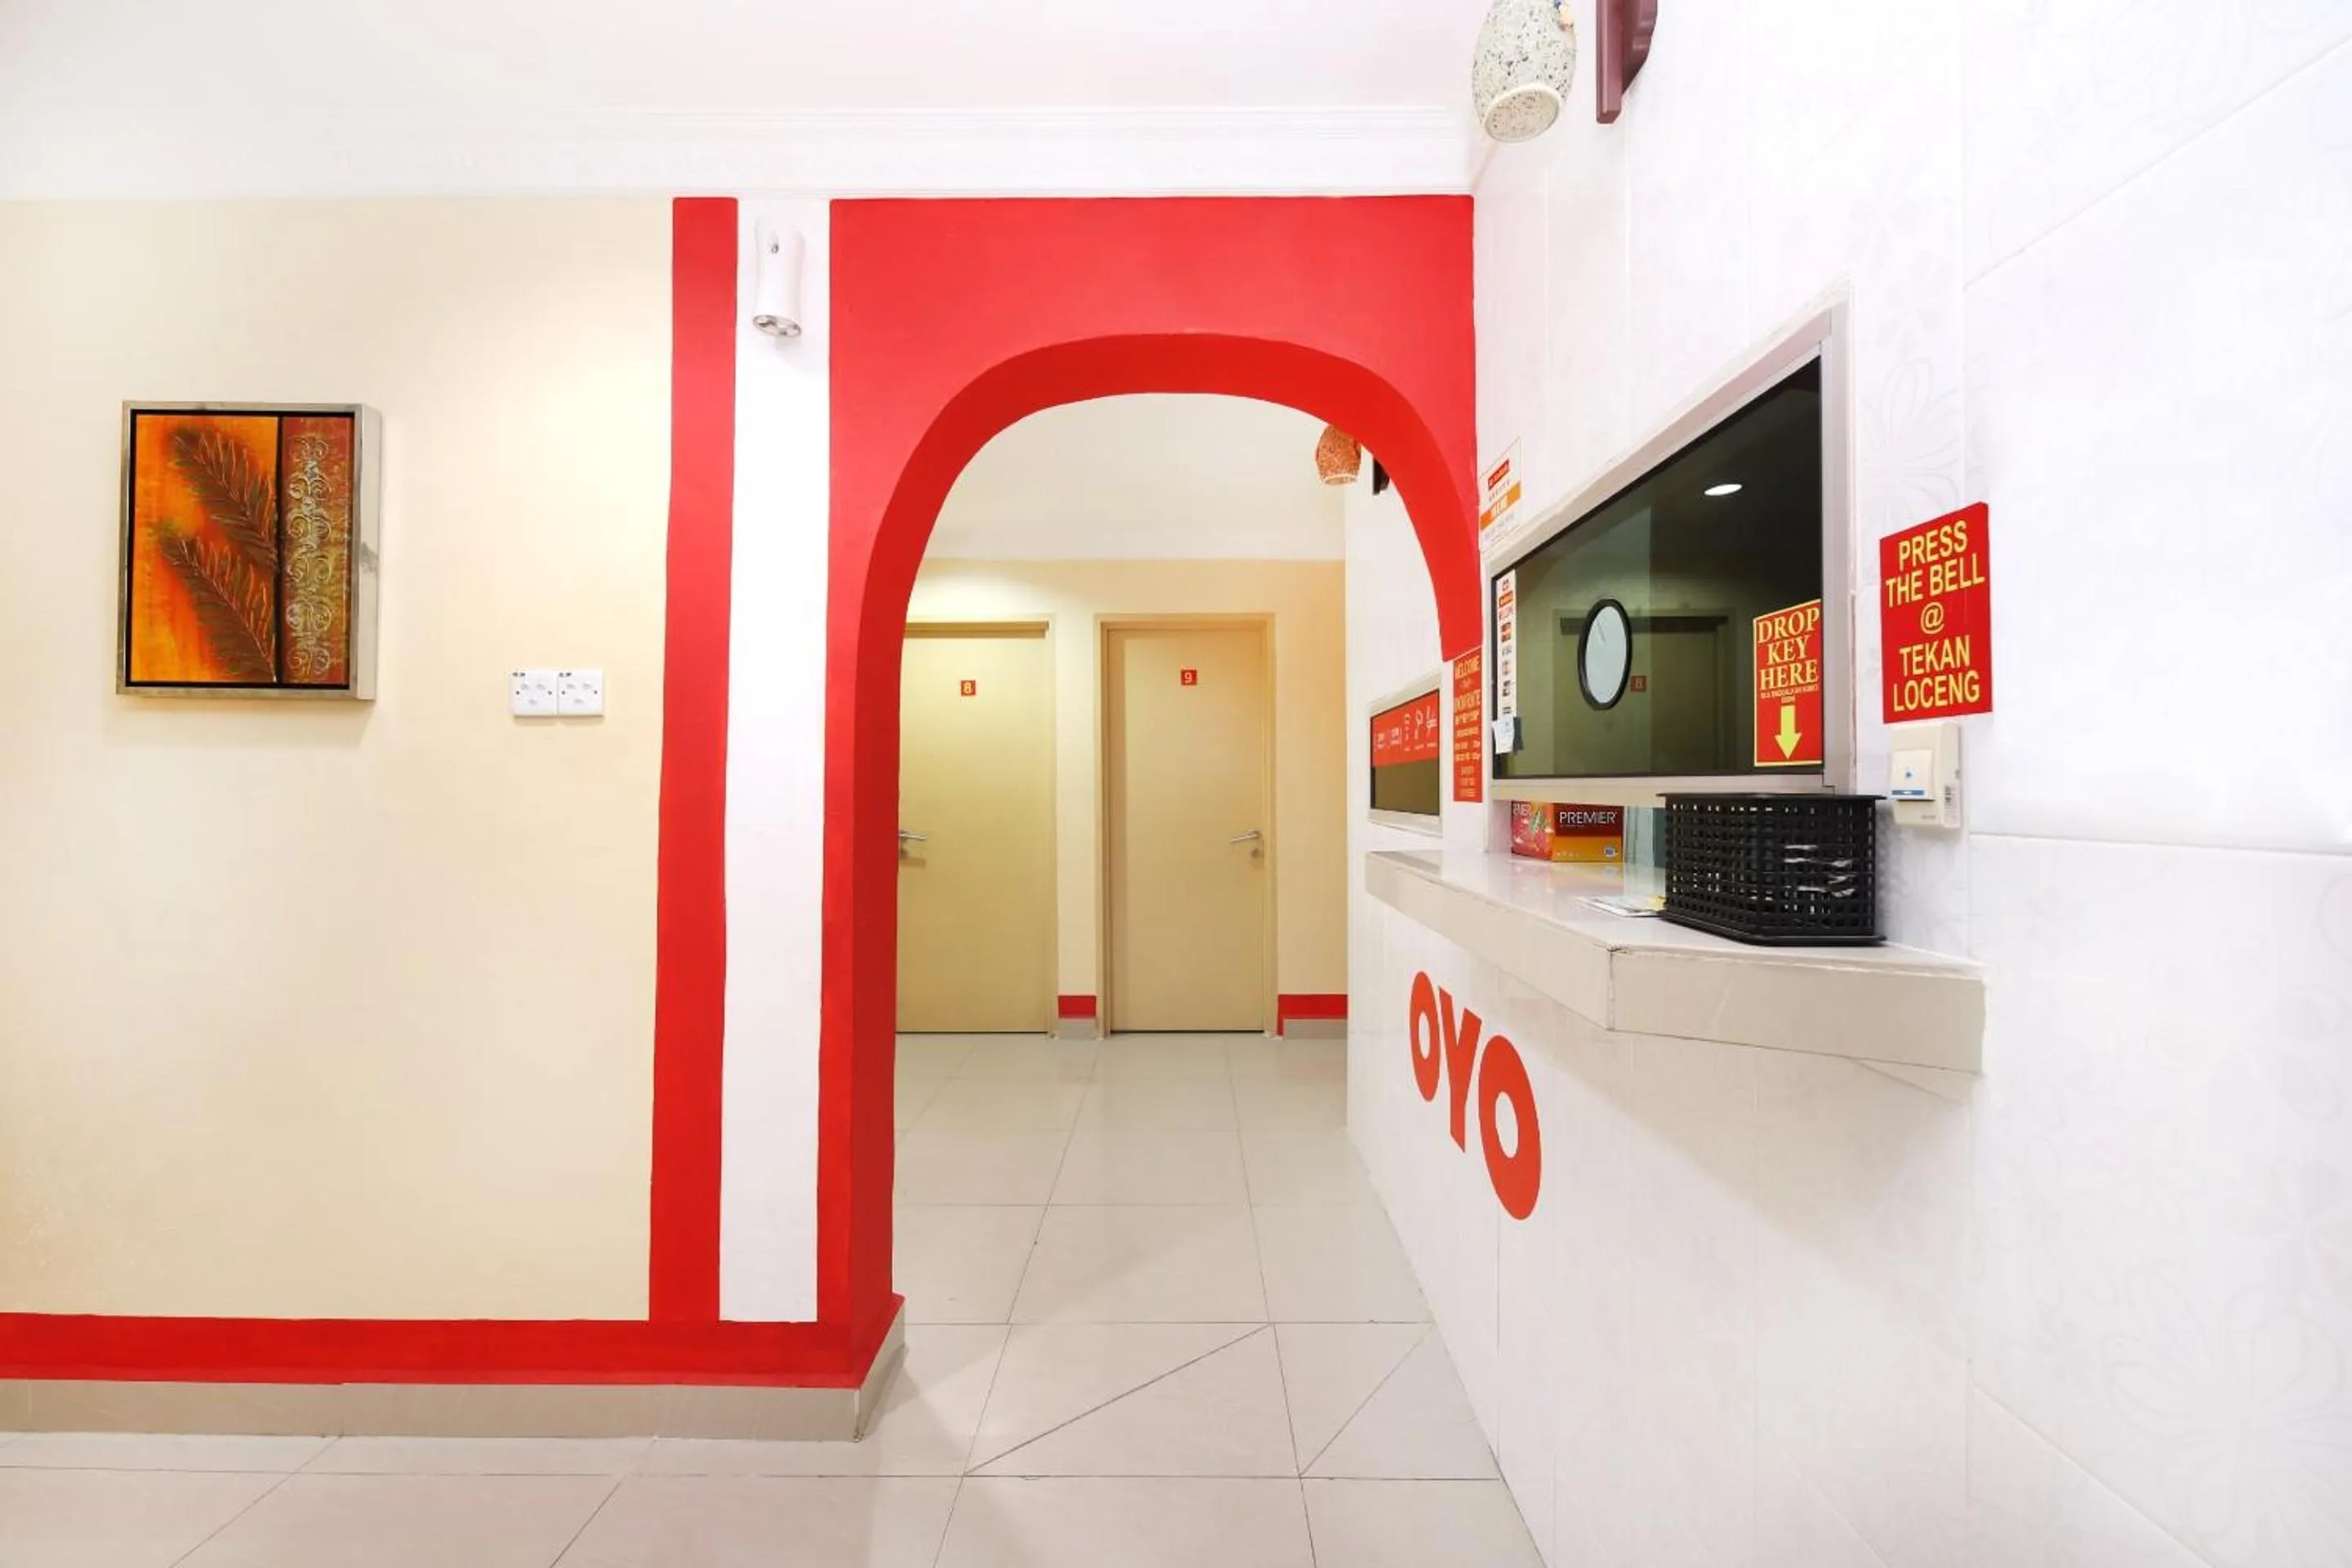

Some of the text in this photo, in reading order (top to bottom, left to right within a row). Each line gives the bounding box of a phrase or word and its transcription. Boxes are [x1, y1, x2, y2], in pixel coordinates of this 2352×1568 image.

[1898, 519, 1968, 572] PRESS
[1886, 552, 1985, 608] THE BELL
[1757, 607, 1820, 644] DROP
[1920, 601, 1945, 635] @
[1767, 634, 1811, 666] KEY
[1900, 635, 1971, 677] TEKAN
[964, 681, 972, 694] 8
[1184, 672, 1192, 684] 9
[1759, 659, 1820, 692] HERE
[1893, 670, 1980, 712] LOCENG
[1559, 811, 1616, 825] PREMIER
[1409, 969, 1542, 1221] OYO
